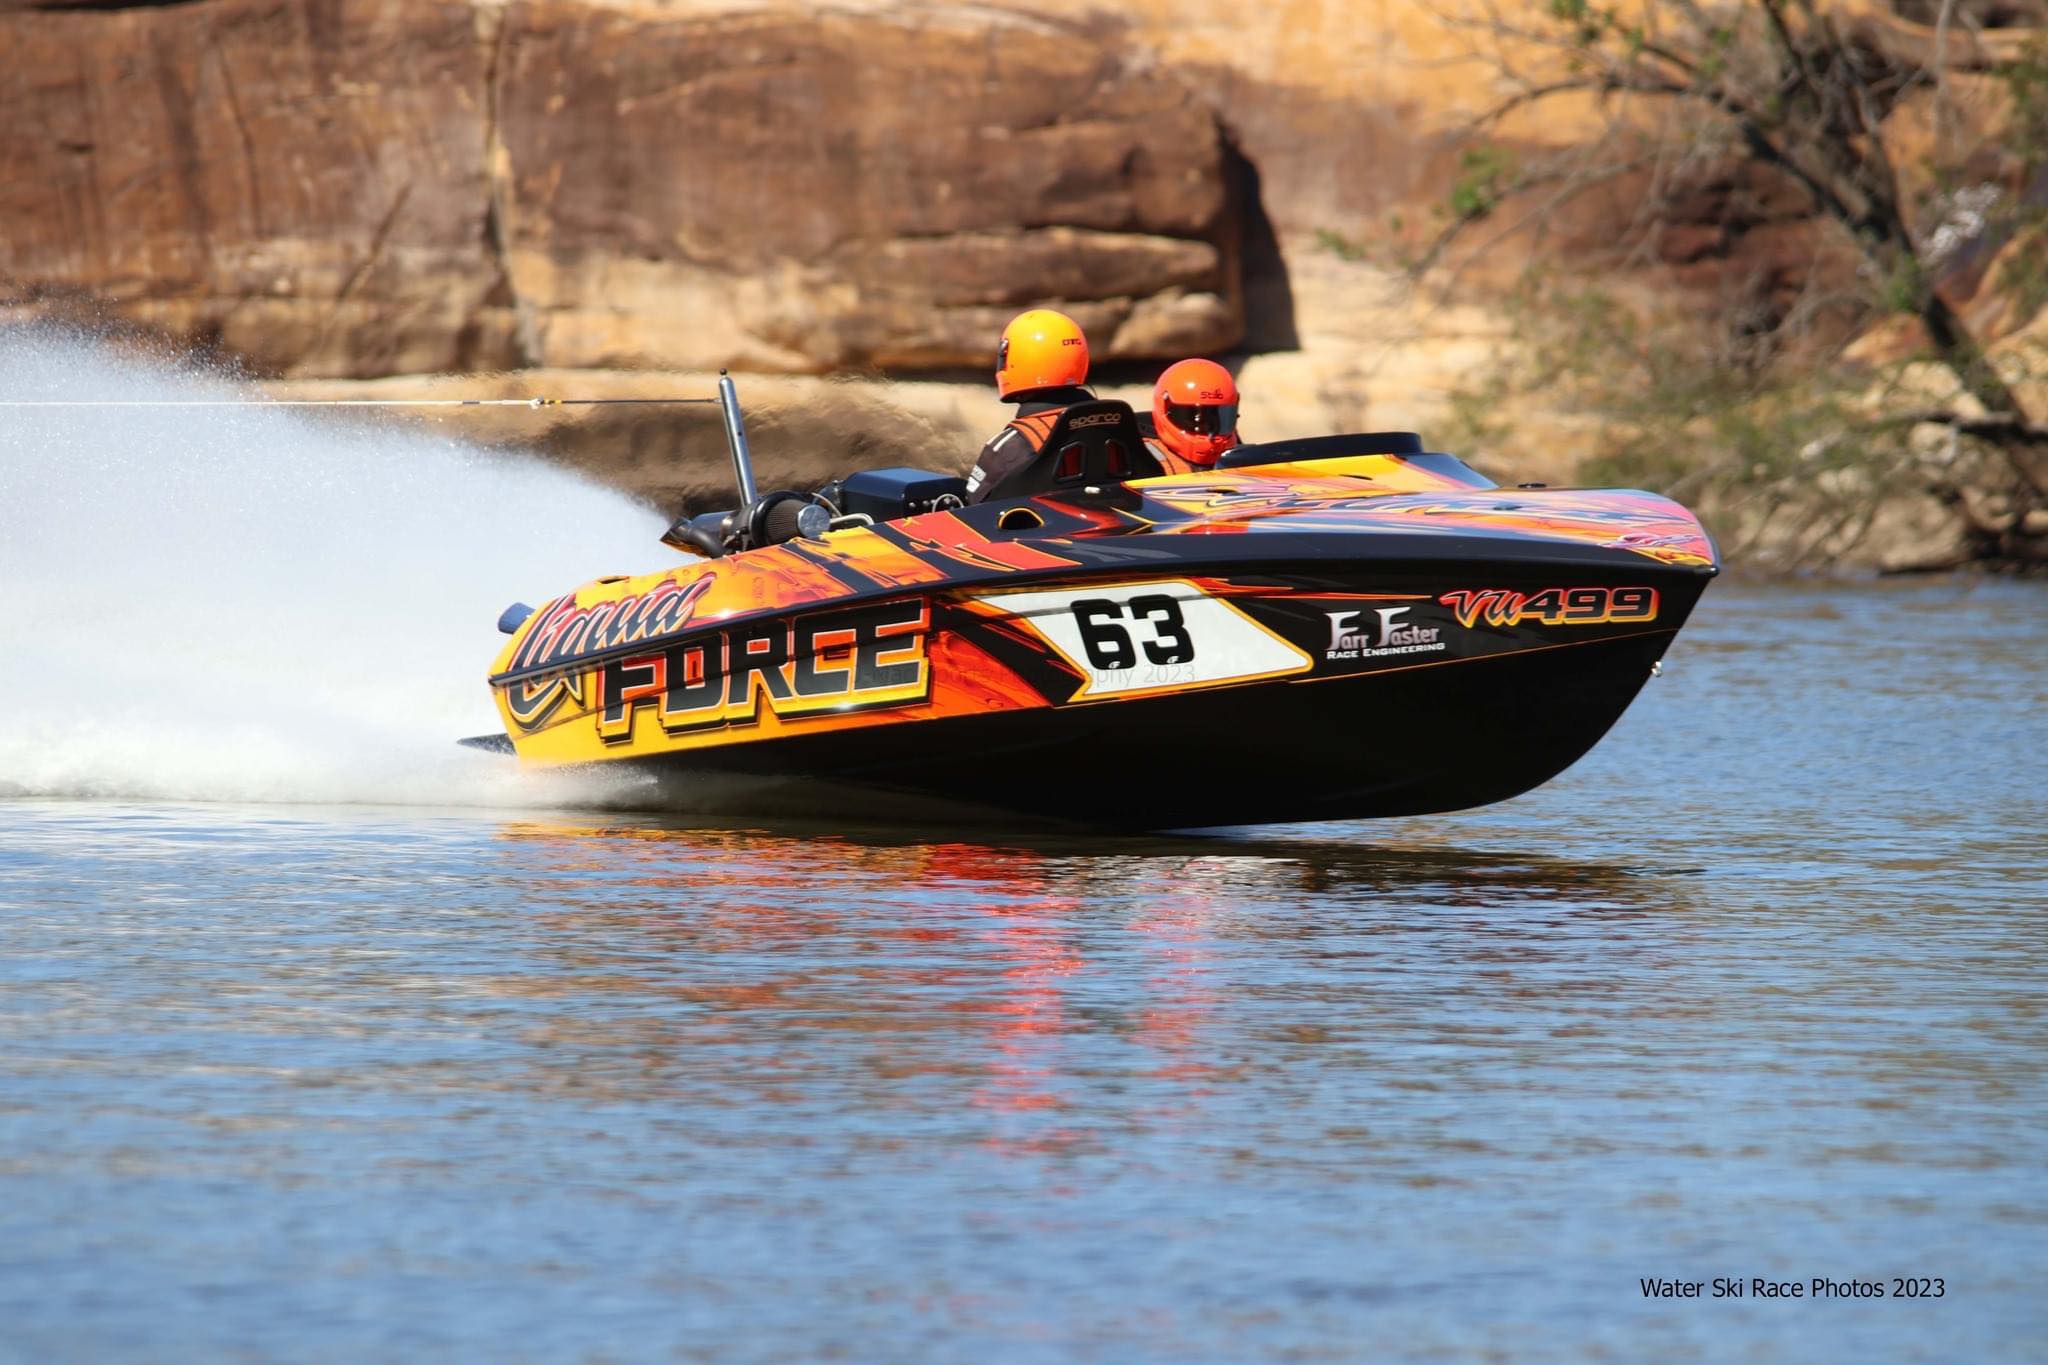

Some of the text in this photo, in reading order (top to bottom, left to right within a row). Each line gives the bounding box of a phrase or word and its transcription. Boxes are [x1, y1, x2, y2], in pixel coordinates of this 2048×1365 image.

[1069, 413, 1121, 428] sparco
[1070, 594, 1196, 670] 63
[1324, 606, 1440, 651] Farr Faster
[597, 598, 932, 746] FORCE
